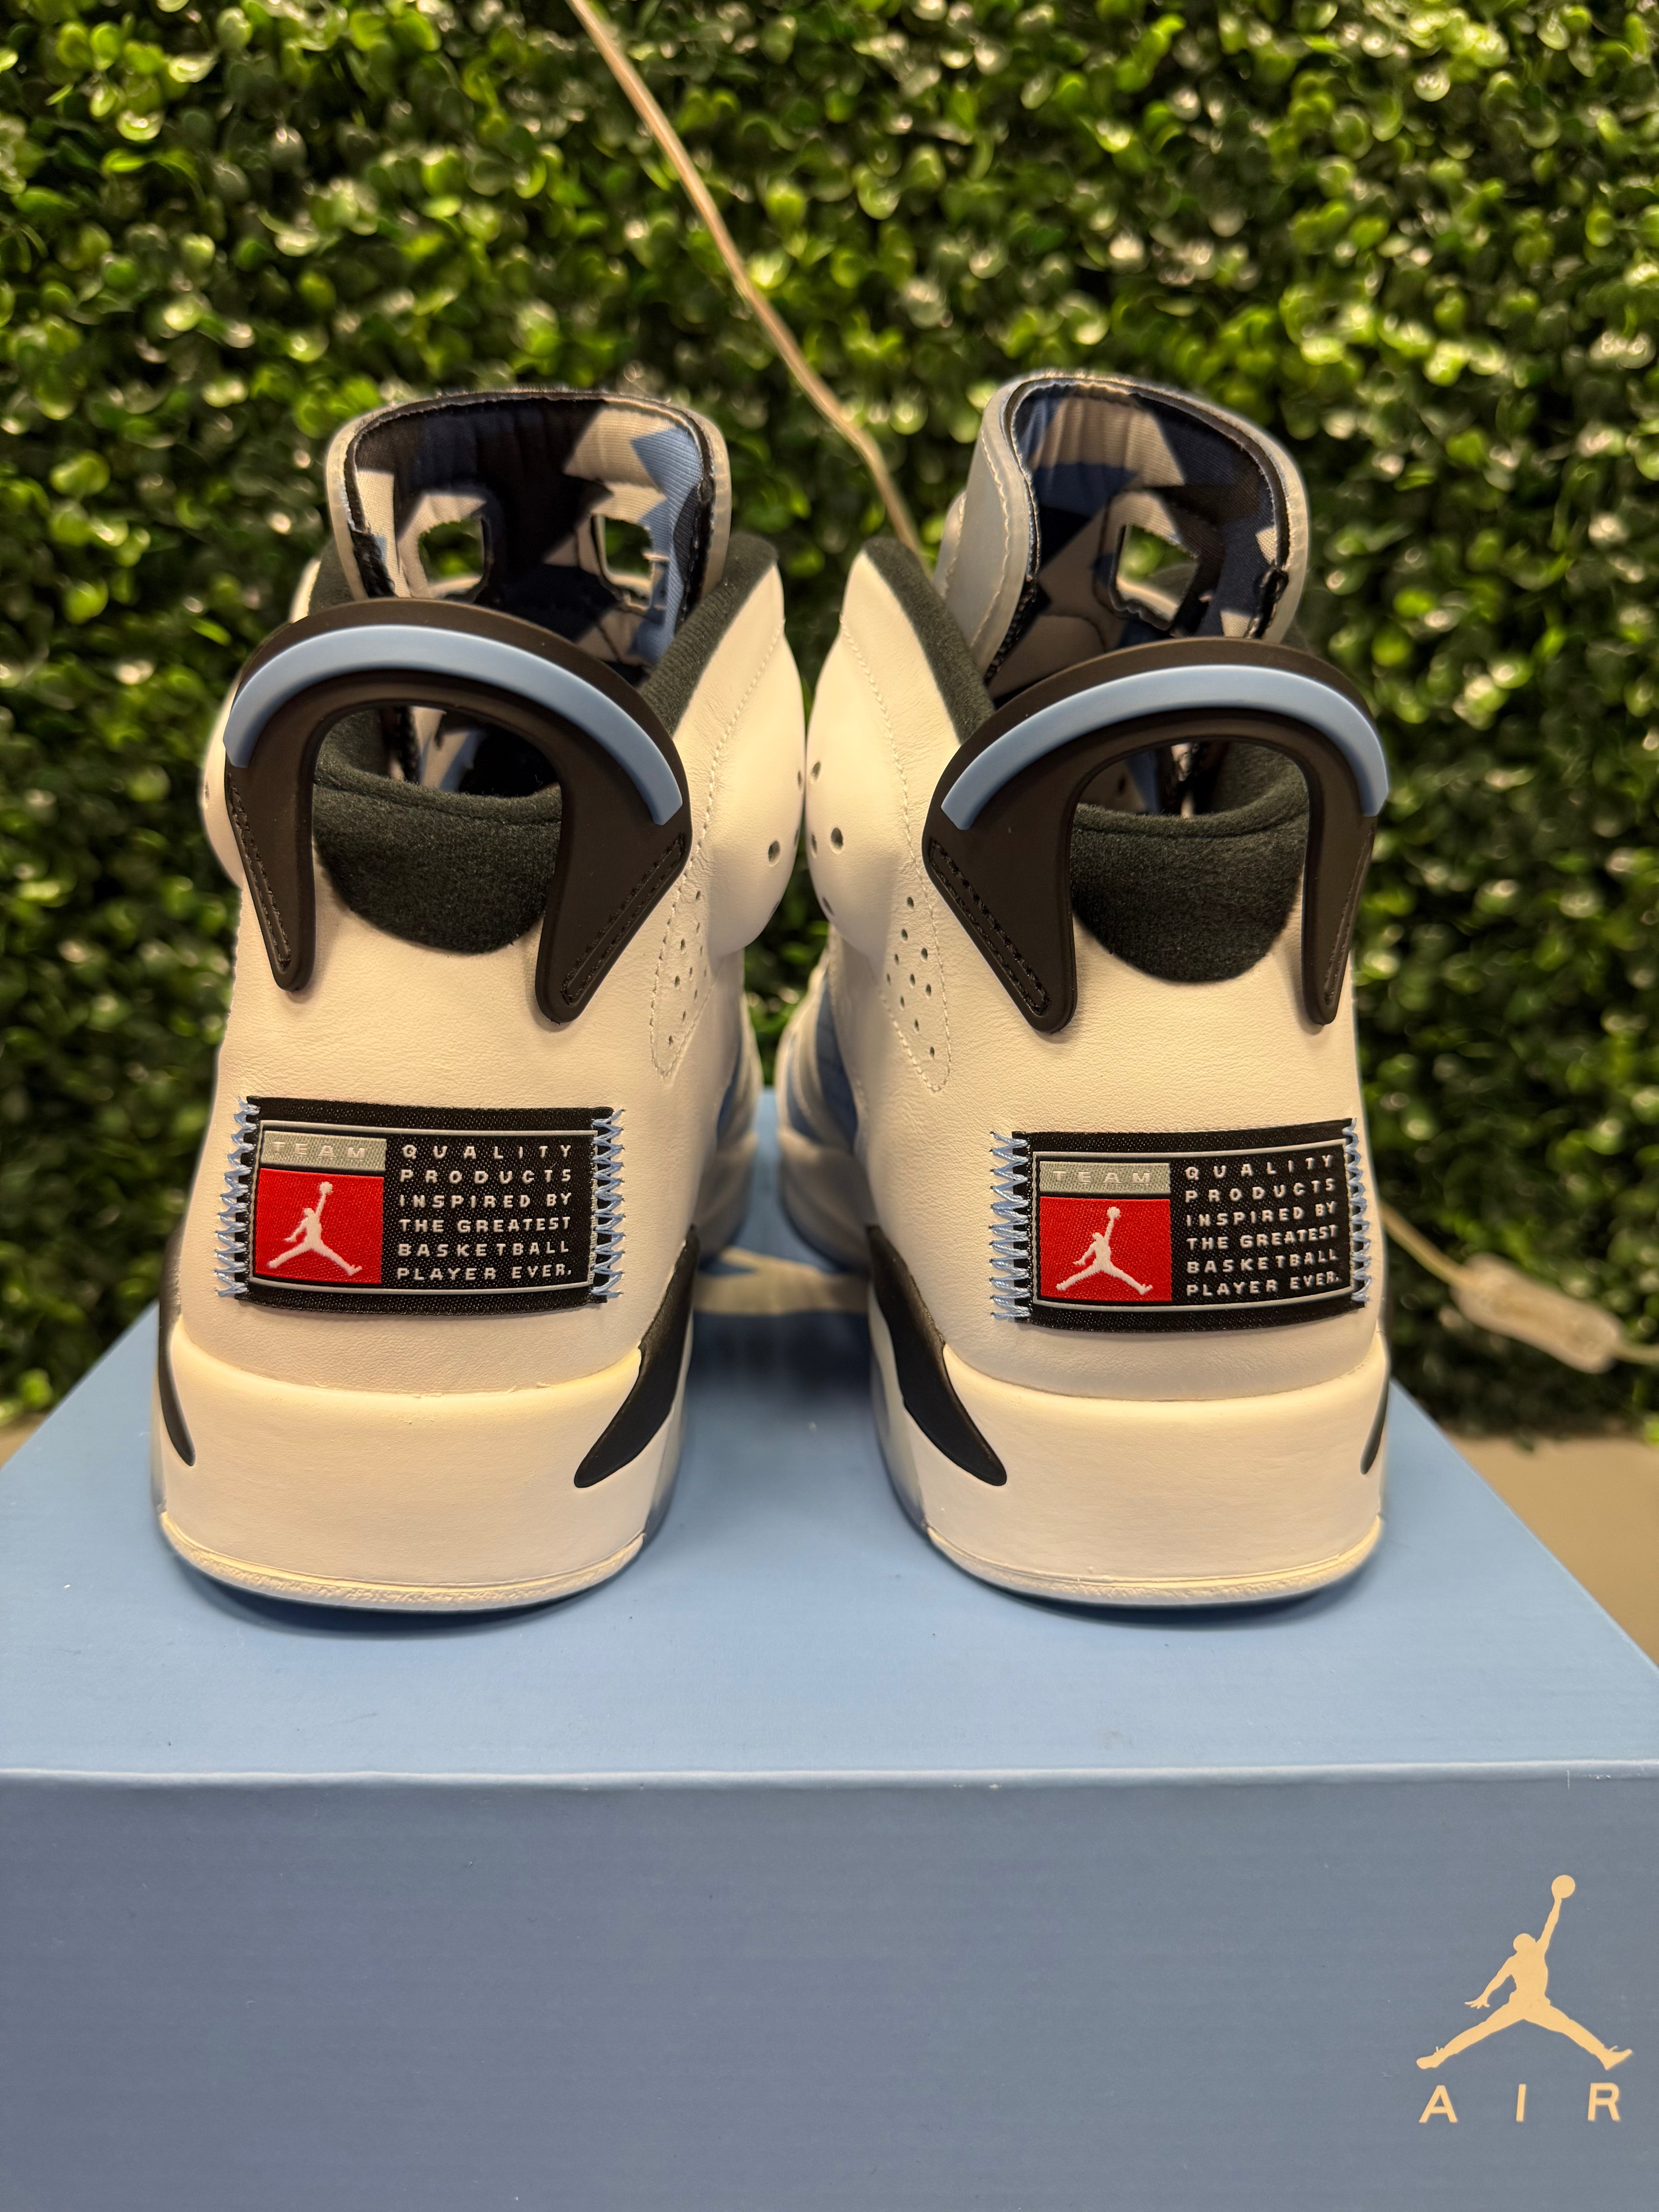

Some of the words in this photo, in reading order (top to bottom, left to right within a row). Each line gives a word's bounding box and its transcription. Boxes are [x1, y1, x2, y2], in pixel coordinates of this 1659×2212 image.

[273, 1141, 366, 1160] TEAM
[403, 1145, 572, 1160] QUALITY
[399, 1169, 571, 1184] PRODUCTS
[1185, 1154, 1334, 1180] QUALITY
[1052, 1171, 1151, 1185] TEAM
[1185, 1178, 1335, 1203] PRODUCTS
[399, 1193, 531, 1208] INSPIRED
[546, 1193, 572, 1206] BY
[1186, 1207, 1303, 1226] INSPIRED
[1315, 1201, 1337, 1217] BY
[399, 1219, 444, 1233] THE
[457, 1217, 571, 1233] GREATEST
[1186, 1236, 1229, 1250] THE
[1239, 1225, 1338, 1248] GREATEST
[398, 1242, 569, 1257] BASKETBALL
[1187, 1249, 1338, 1274] BASKETBALL
[397, 1267, 497, 1281] PLAYER
[512, 1263, 572, 1278] EVER.
[1186, 1280, 1278, 1296] PLAYER
[1290, 1272, 1341, 1289] EVER.
[1419, 2082, 1620, 2123] AIR
